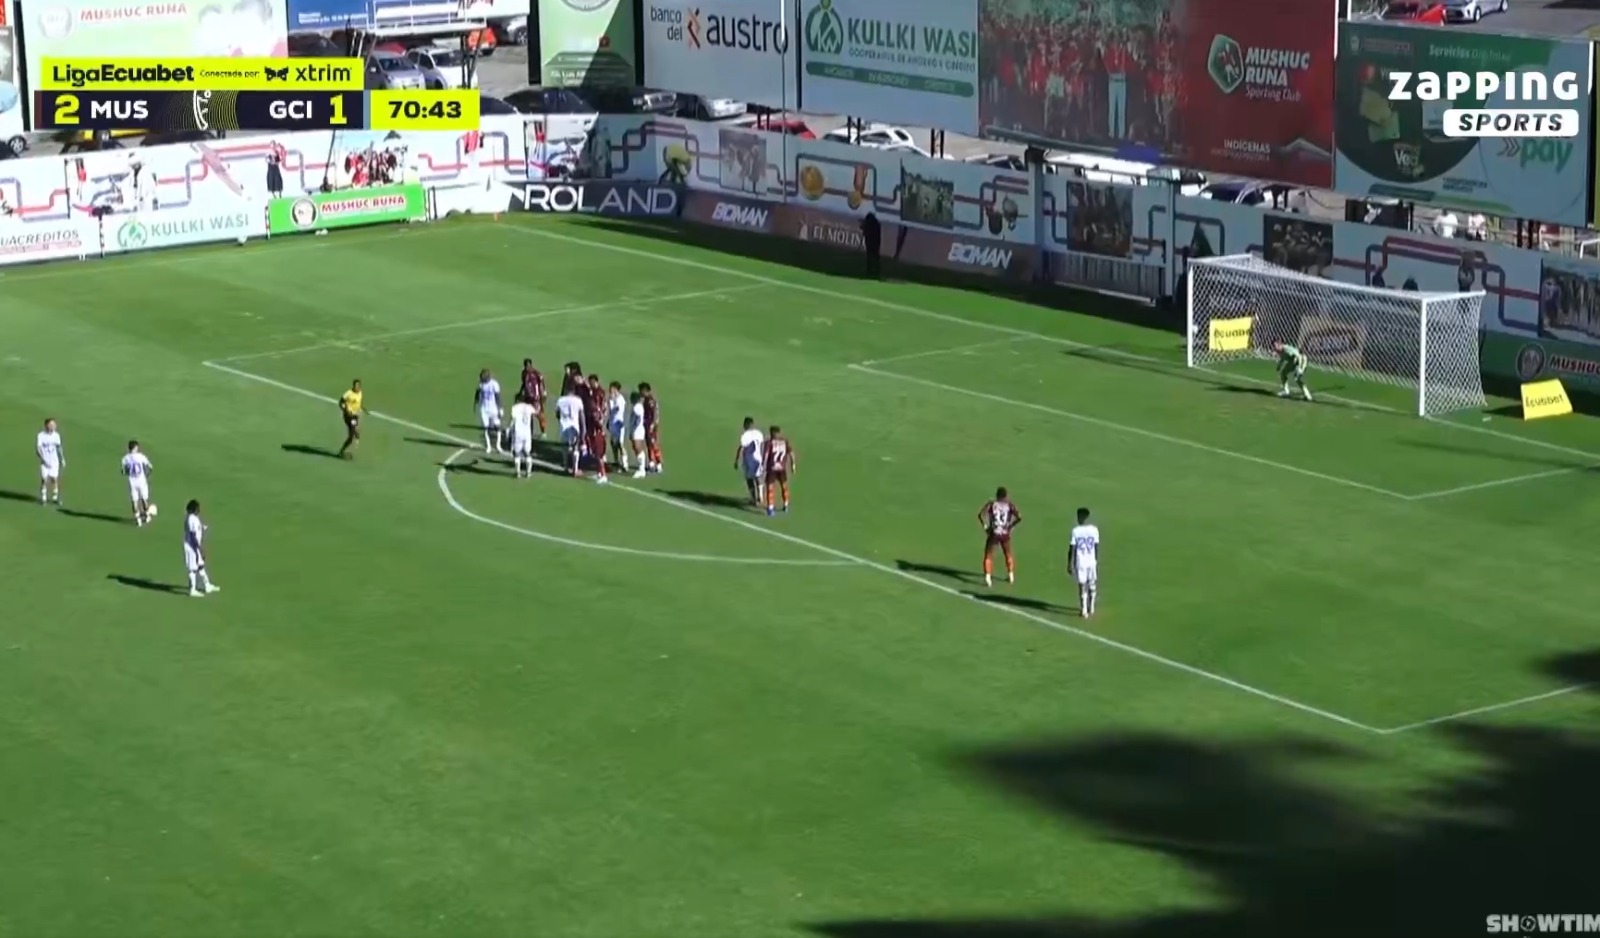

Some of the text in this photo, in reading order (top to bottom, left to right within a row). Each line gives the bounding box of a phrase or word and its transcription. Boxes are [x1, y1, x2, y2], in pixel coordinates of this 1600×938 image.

[80, 3, 187, 21] MUSHUC RUNA
[651, 5, 683, 24] banco
[667, 26, 683, 41] del
[706, 13, 789, 54] austro
[848, 17, 977, 59] KULLKI WASI
[1245, 47, 1310, 70] MUSHUC
[1245, 66, 1288, 86] RUNA
[1245, 85, 1301, 102] Sporting Club
[1519, 139, 1574, 174] pay
[321, 196, 405, 213] MUSHUC RUNA
[524, 184, 678, 214] ROLAND
[151, 213, 249, 237] KULLKI WASI
[711, 202, 768, 229] BOMAN
[813, 225, 823, 240] EL
[947, 242, 1013, 270] BOMAN
